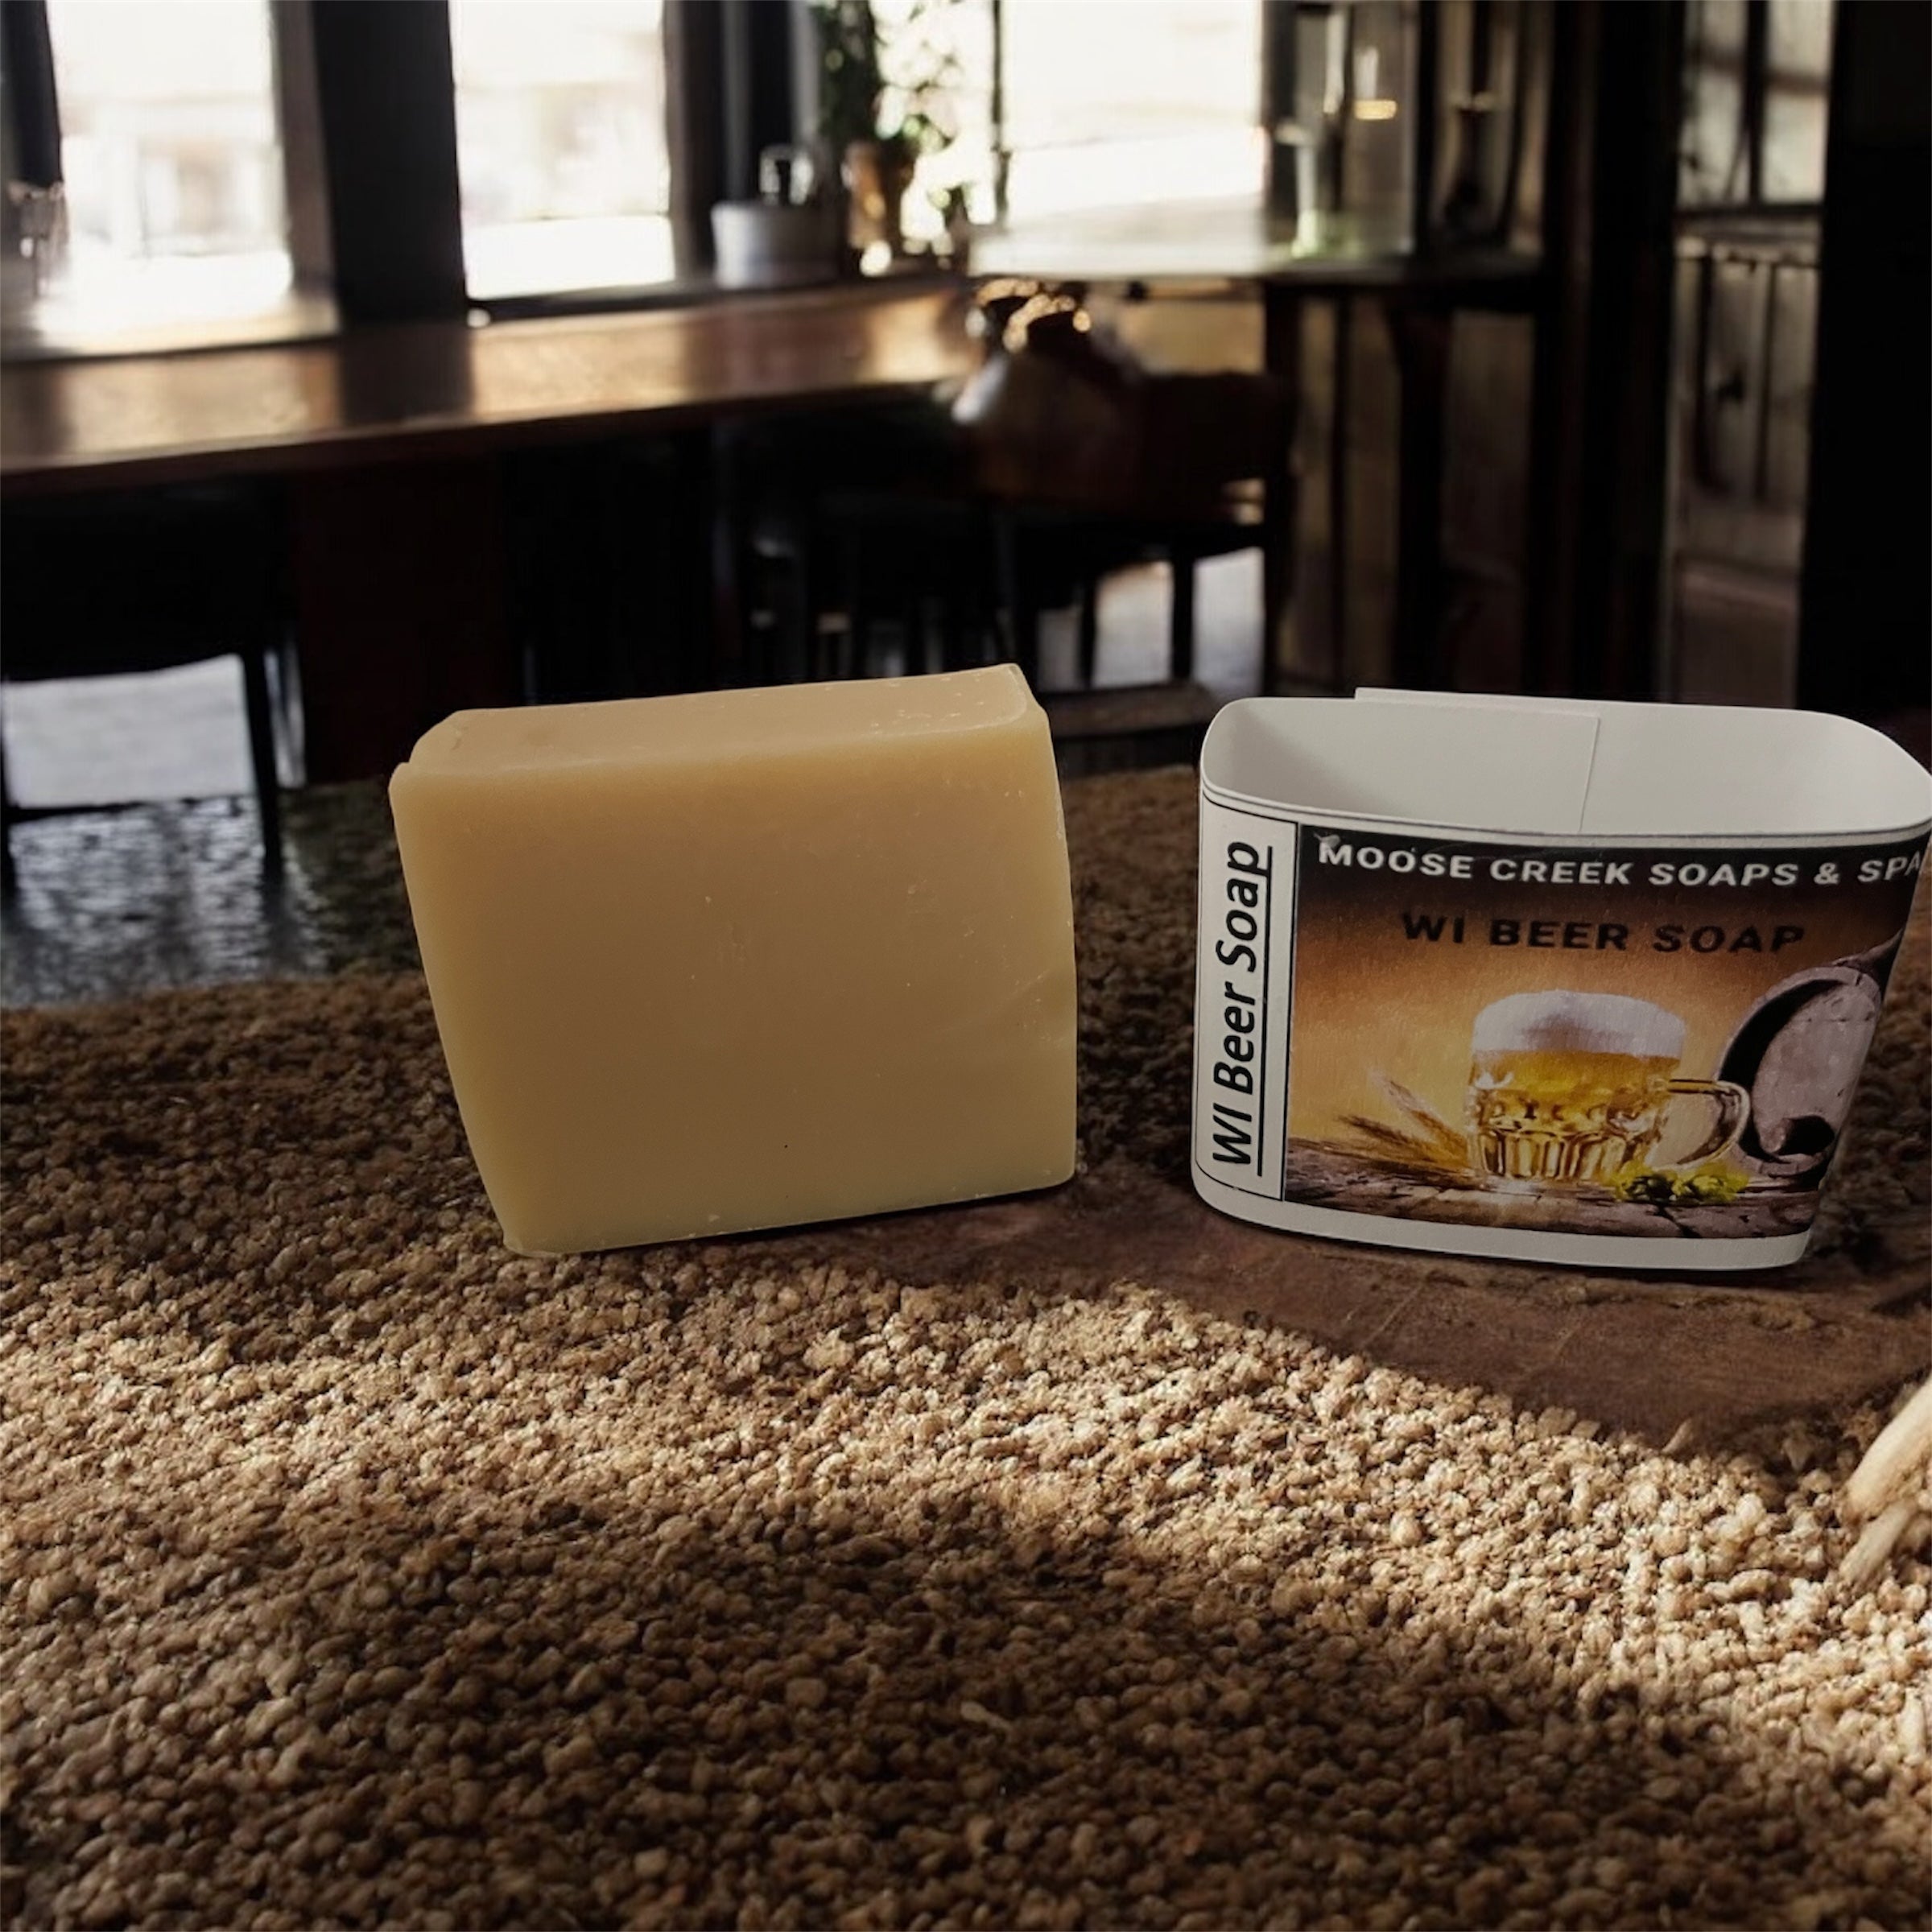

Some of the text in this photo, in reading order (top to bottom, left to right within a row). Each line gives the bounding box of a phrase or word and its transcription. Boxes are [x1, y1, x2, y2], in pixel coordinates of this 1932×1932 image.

[1318, 842, 1921, 886] MOOSE CREEK SOAPS & SPA
[1402, 911, 1805, 953] WI BEER SOAP
[1212, 841, 1269, 1165] WI Beer Soap
